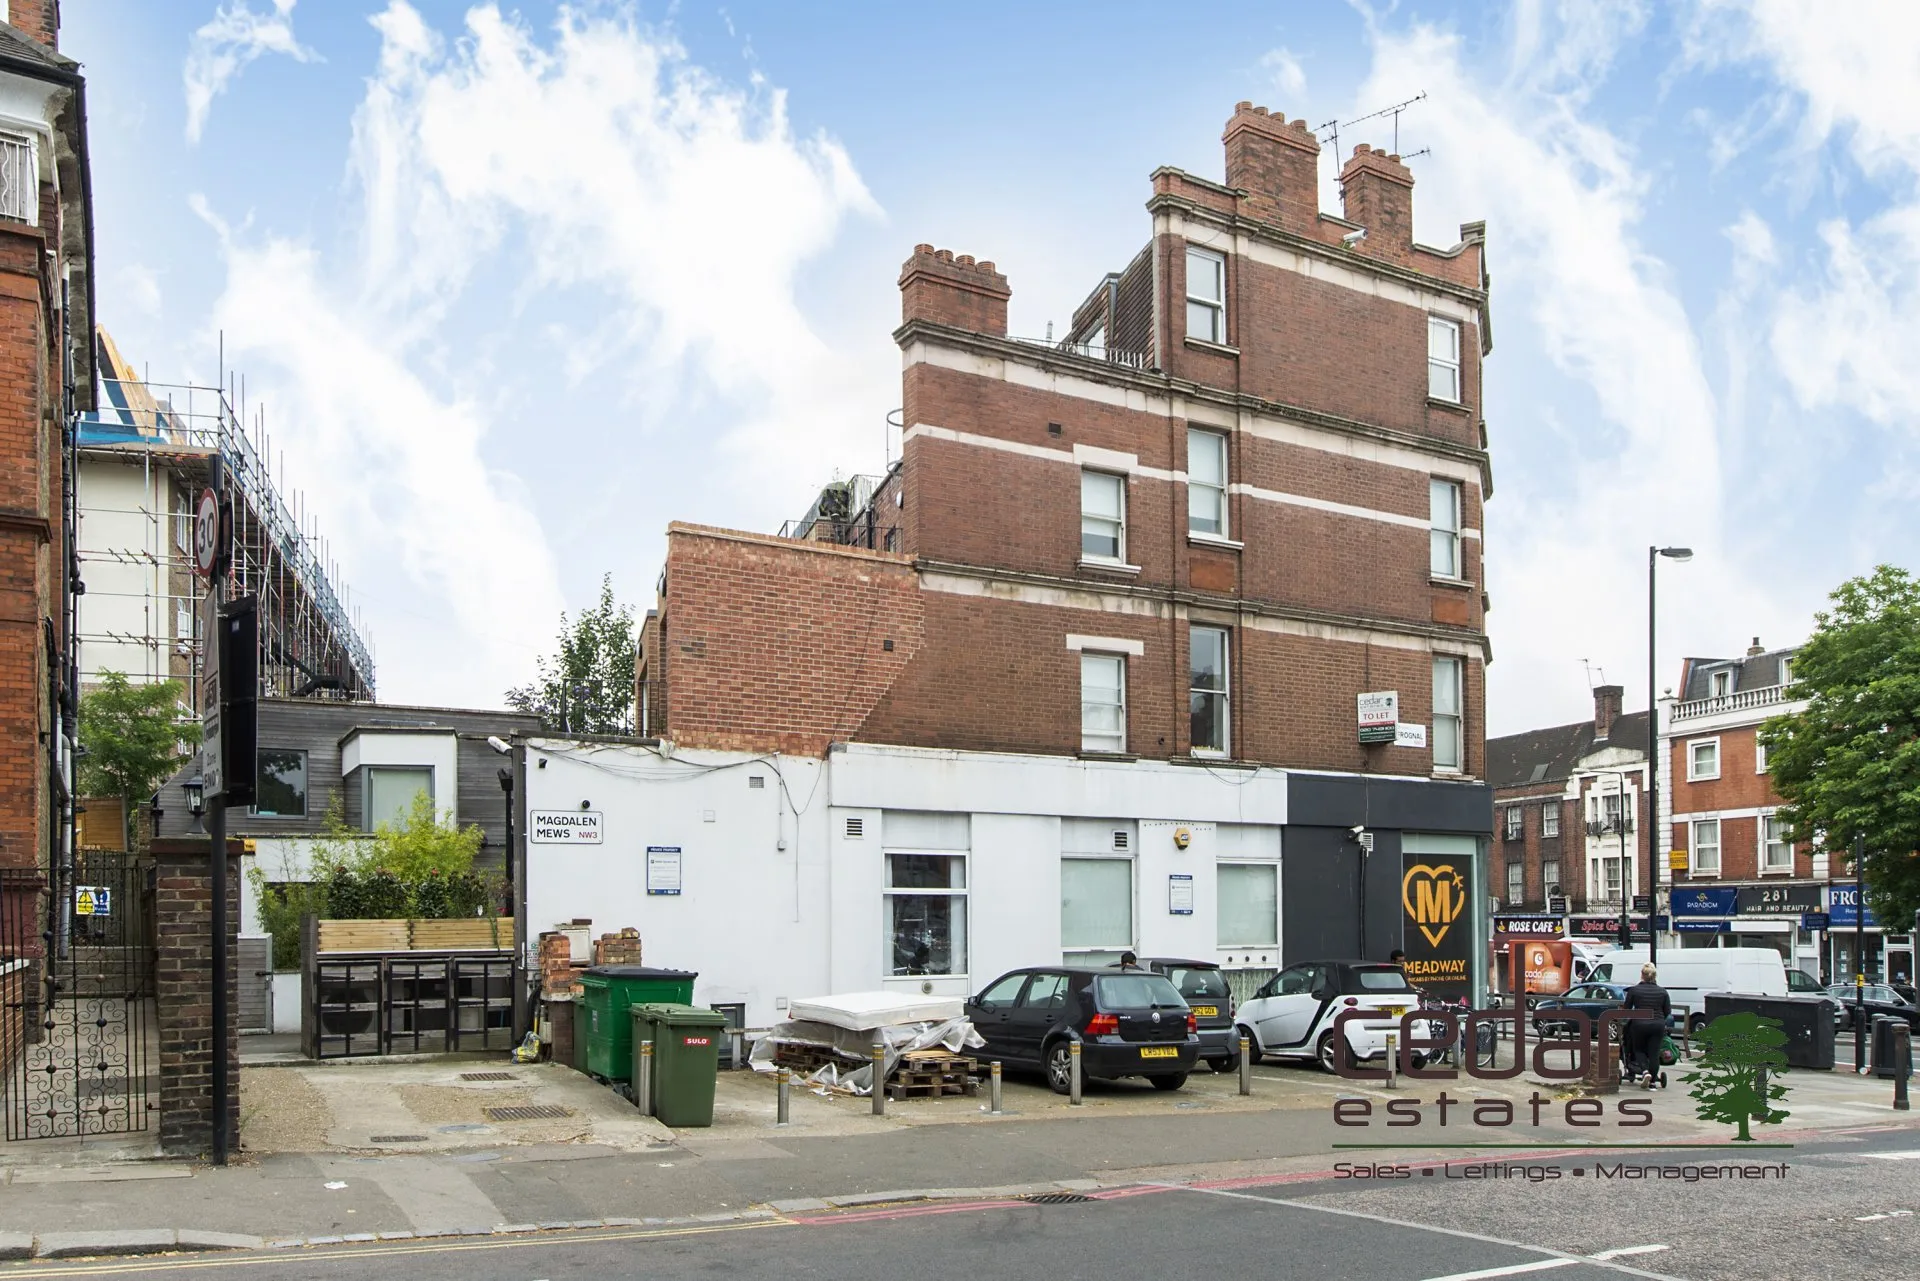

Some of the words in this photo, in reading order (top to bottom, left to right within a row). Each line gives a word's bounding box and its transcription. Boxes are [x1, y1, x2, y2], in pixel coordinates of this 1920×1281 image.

[199, 511, 215, 554] 30
[1359, 694, 1383, 706] cedar
[1376, 712, 1390, 720] LET
[536, 815, 597, 826] MAGDALEN
[536, 829, 571, 838] MEWS
[578, 831, 598, 839] NW3
[1763, 889, 1788, 902] 281
[1687, 901, 1718, 909] PARADIGM
[1782, 904, 1810, 912] BEAUTY
[1508, 921, 1531, 933] ROSE
[1532, 921, 1554, 933] CAFE
[1581, 920, 1604, 933] Spice
[1404, 960, 1466, 974] MEADWAY
[1525, 968, 1560, 979] cado.com
